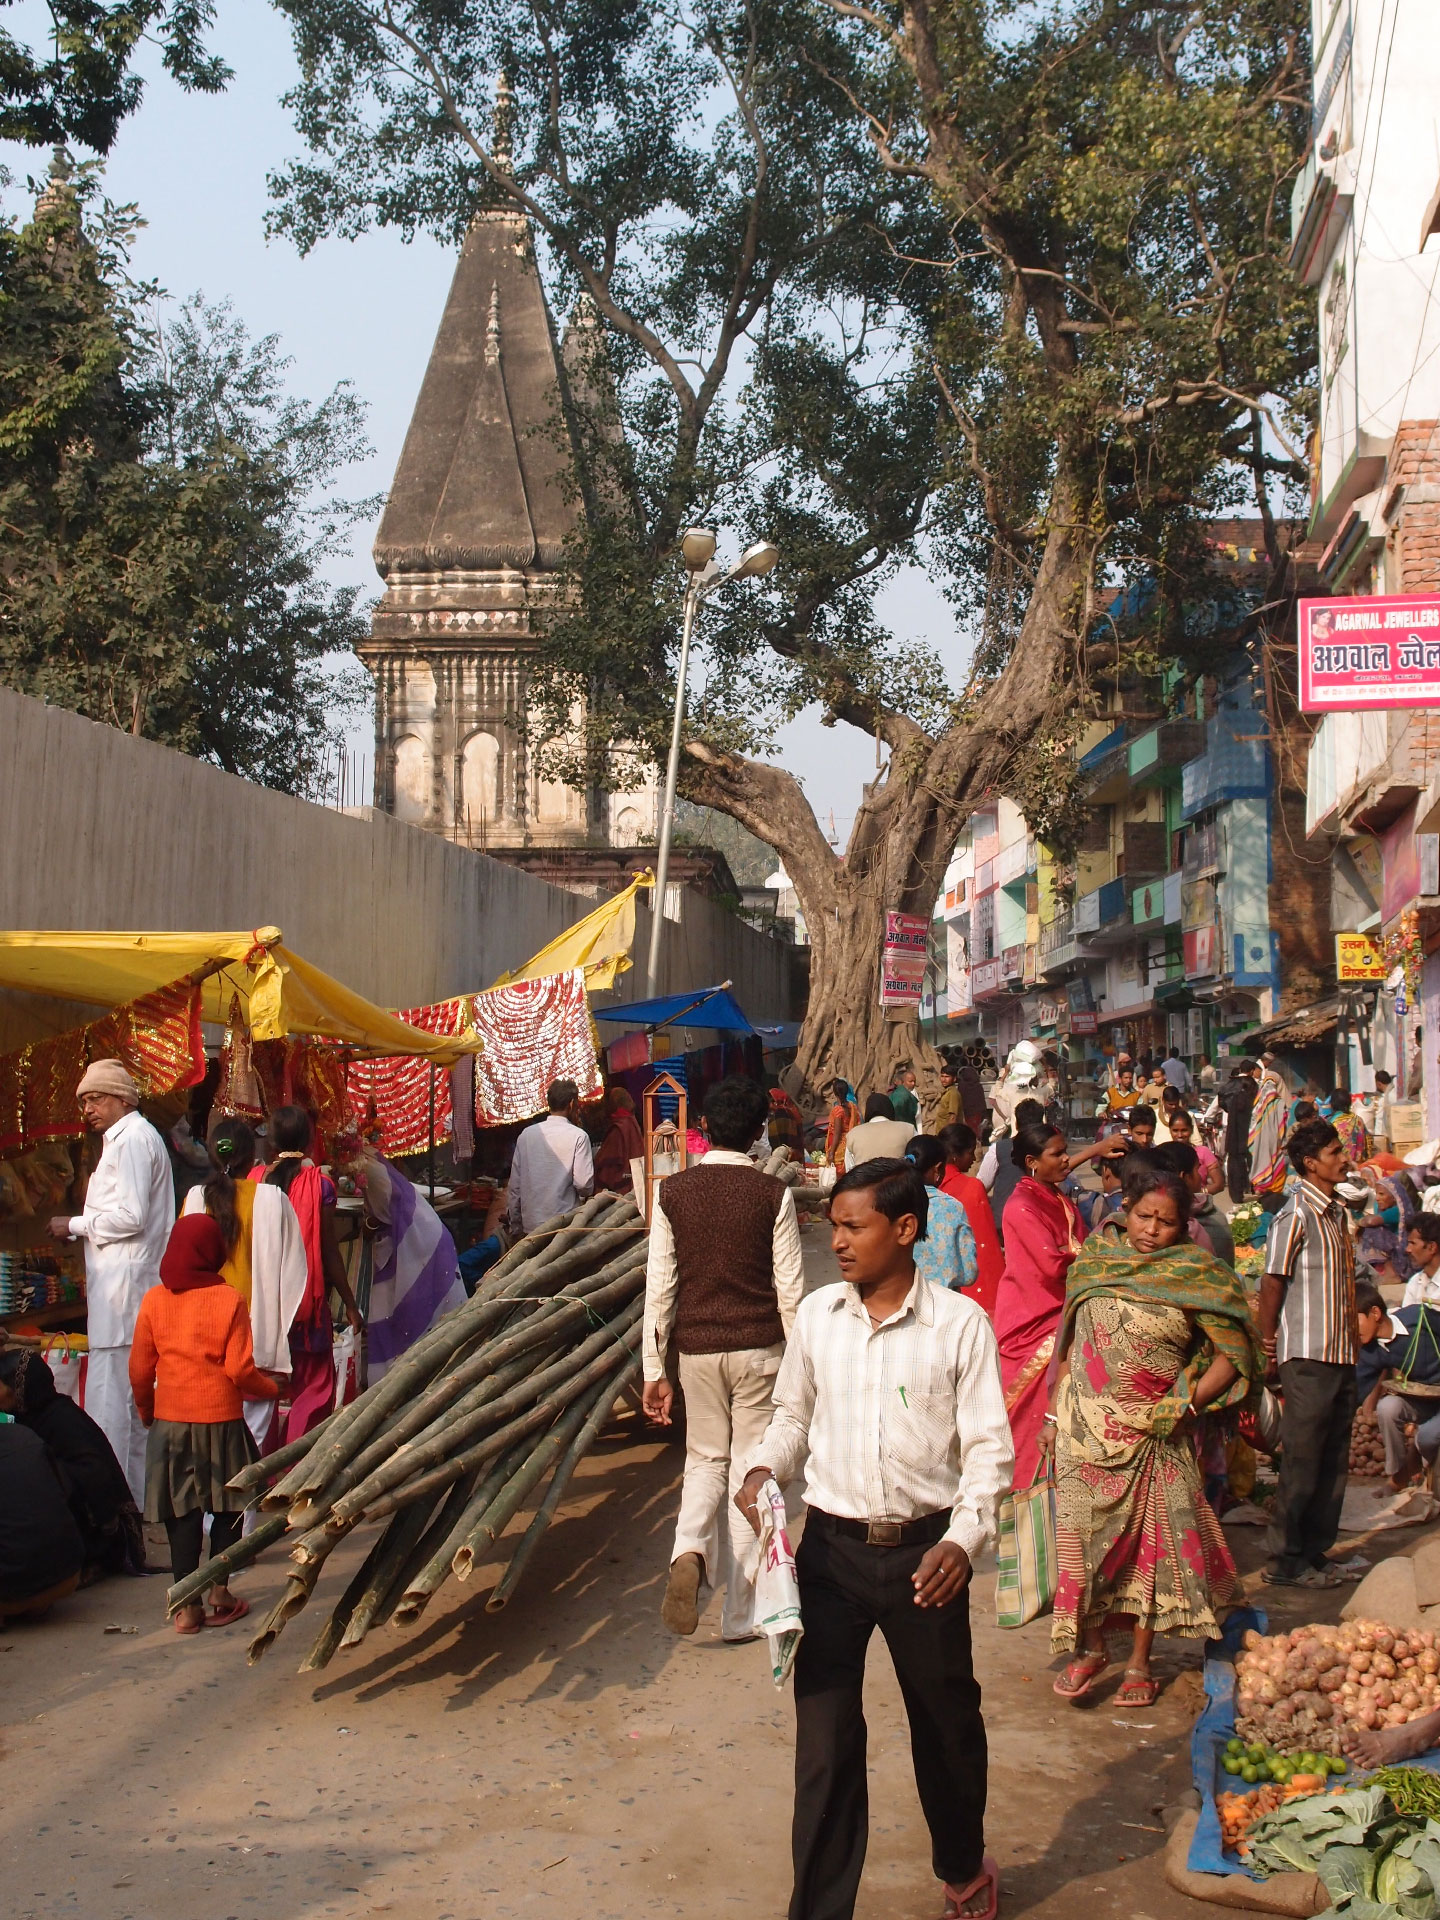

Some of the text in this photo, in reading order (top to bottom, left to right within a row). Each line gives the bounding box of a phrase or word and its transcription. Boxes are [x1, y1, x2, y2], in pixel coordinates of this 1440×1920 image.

[1335, 609, 1440, 631] AGARWAL JEWELLERS
[1313, 644, 1390, 673] अग्रवाल
[888, 931, 910, 944] अग्रवाल
[885, 980, 908, 991] अग्रवाल
